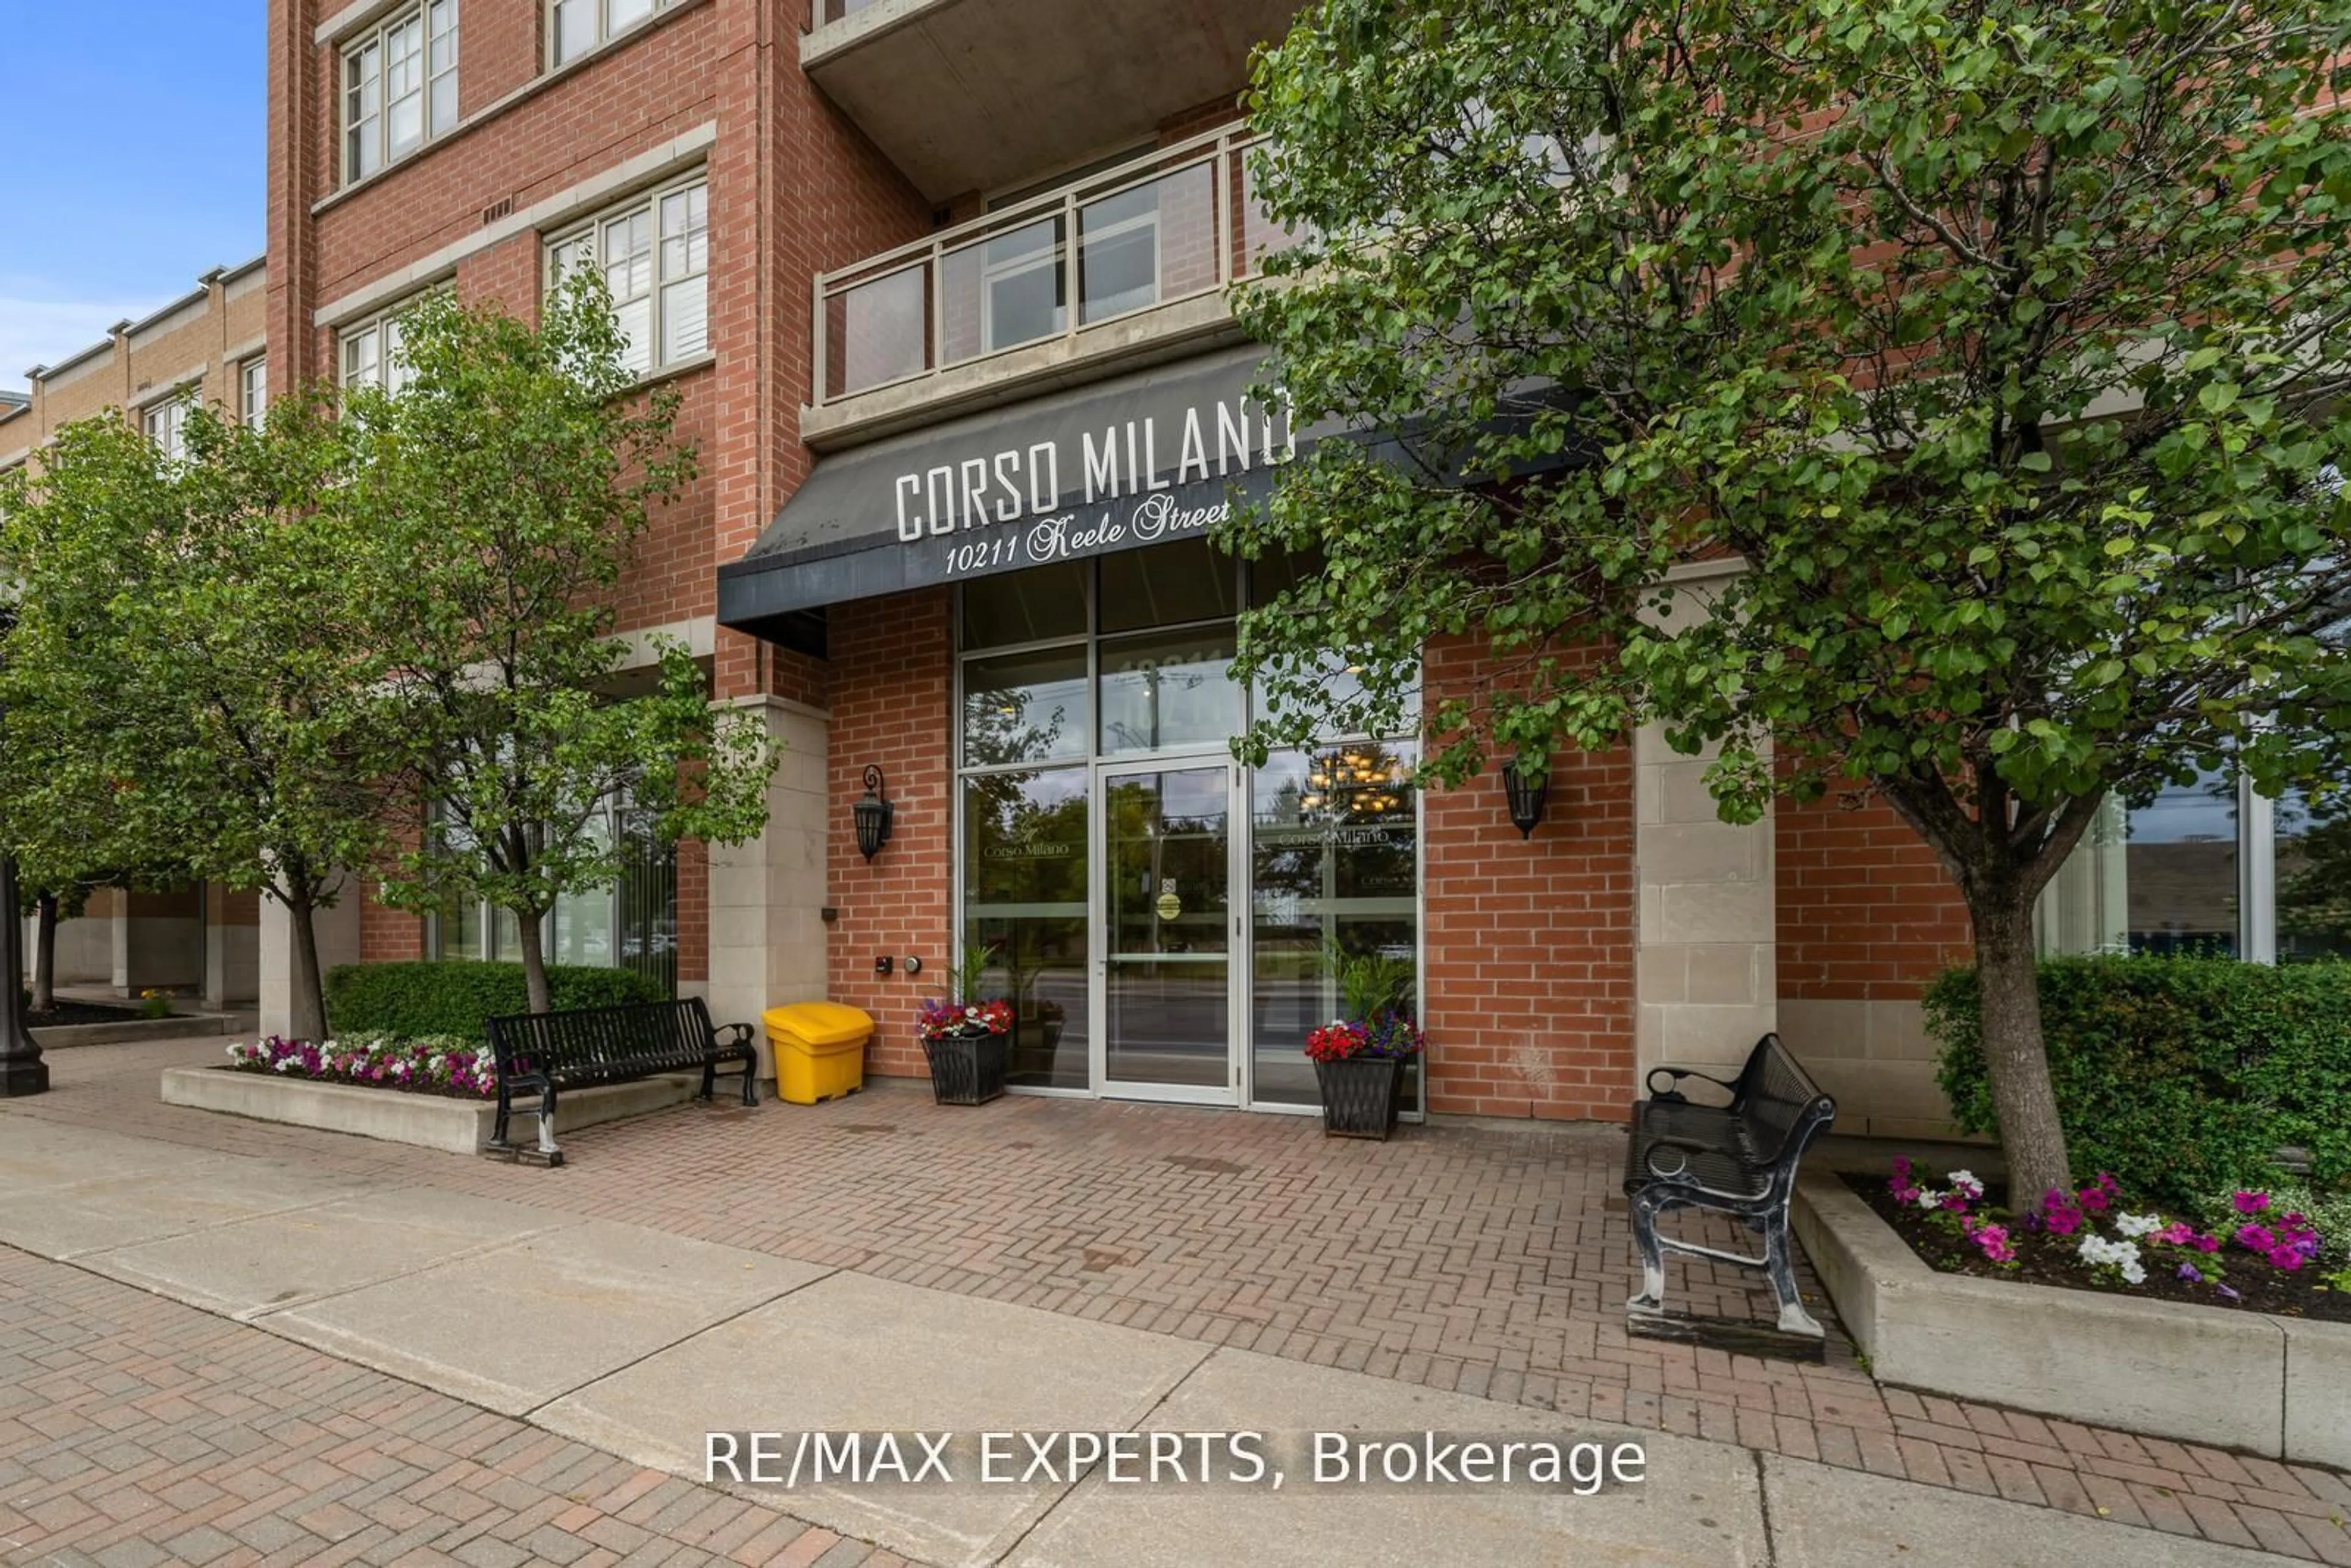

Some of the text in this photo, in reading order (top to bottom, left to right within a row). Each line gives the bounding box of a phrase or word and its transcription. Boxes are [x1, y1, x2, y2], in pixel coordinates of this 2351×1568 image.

[896, 386, 1295, 542] CORSO MILANO
[945, 493, 1231, 575] 10211 Keele Street
[984, 842, 1070, 858] Corso Milano
